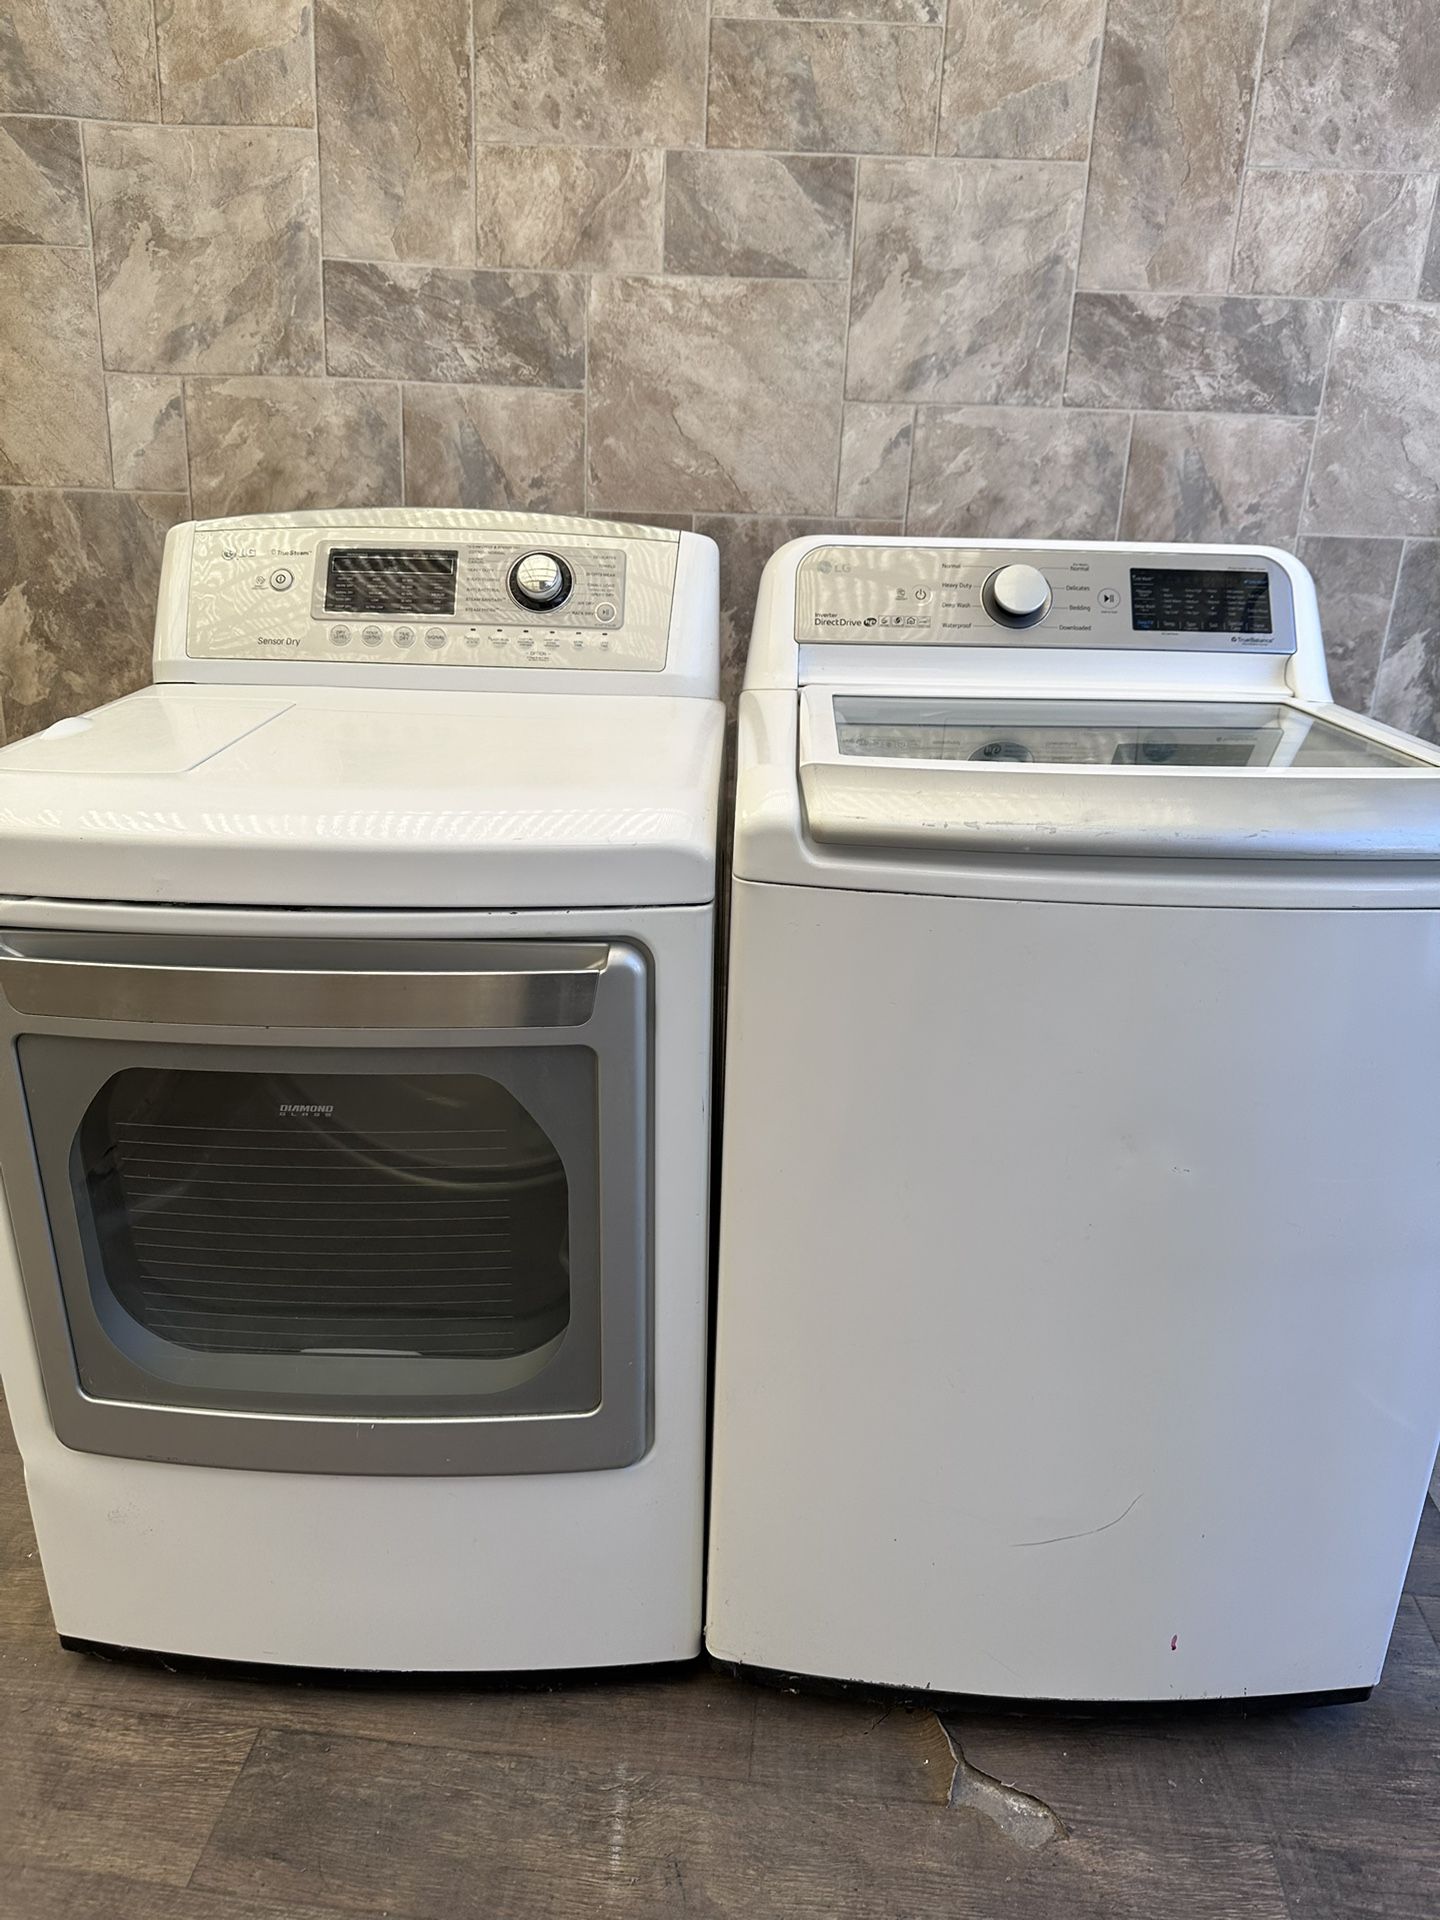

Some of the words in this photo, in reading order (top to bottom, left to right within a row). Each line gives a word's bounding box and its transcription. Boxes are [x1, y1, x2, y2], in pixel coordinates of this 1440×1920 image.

[834, 563, 852, 573] LG
[959, 582, 973, 590] Duty
[1069, 604, 1091, 612] Bedding
[942, 622, 972, 630] Waterproof
[257, 636, 285, 646] Sensor
[285, 637, 301, 648] Dry
[279, 1104, 334, 1113] DIAMOND
